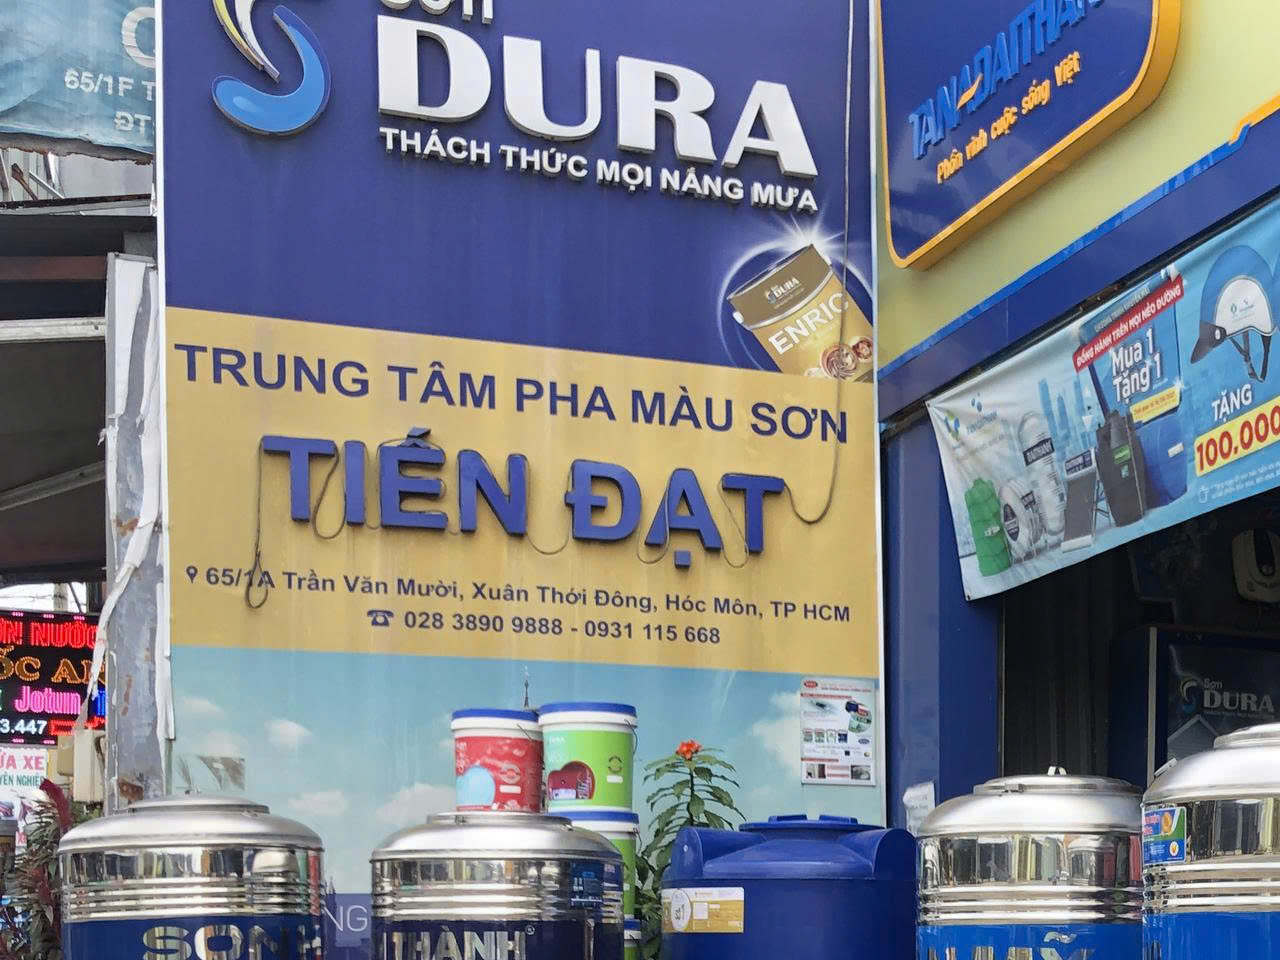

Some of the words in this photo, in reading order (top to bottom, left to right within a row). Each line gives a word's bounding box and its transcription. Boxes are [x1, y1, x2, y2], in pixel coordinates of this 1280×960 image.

[377, 15, 818, 178] DURA
[966, 128, 989, 160] vinh
[1021, 79, 1050, 115] sống
[1054, 50, 1081, 87] Việt
[379, 126, 491, 167] THÁCH
[499, 144, 589, 181] THỨC
[597, 158, 652, 192] MỌI
[751, 181, 819, 212] MƯA
[768, 292, 849, 355] ENRIC
[1112, 342, 1143, 377] Mua
[1146, 327, 1154, 354] 1
[174, 344, 370, 398] TRUNG
[387, 360, 496, 410] TÂM
[516, 378, 616, 421] PHA
[631, 385, 734, 432] MÀU
[751, 402, 848, 443] SƠN
[1113, 360, 1150, 405] Tặng
[1154, 353, 1162, 379] 1
[1212, 383, 1253, 423] TẶNG
[261, 427, 528, 537] TIẾN
[564, 458, 785, 569] ĐẠT
[282, 568, 336, 592] Trần
[343, 575, 389, 595] Văn
[397, 577, 464, 601] Mười,
[471, 582, 529, 603] Xuân
[536, 585, 587, 606] Thới
[594, 589, 658, 614] Đông,
[665, 594, 707, 613] Hóc
[713, 597, 764, 619] Môn,
[770, 600, 797, 618] TP
[803, 603, 851, 622] HCM
[404, 611, 444, 630] 028
[452, 613, 504, 633] 3890
[511, 616, 563, 636] 9888
[585, 619, 633, 639] 0931
[643, 623, 678, 642] 115
[684, 626, 721, 645] 668
[14, 685, 81, 715] Jotun
[1203, 690, 1275, 713] DURA
[23, 755, 44, 770] XE
